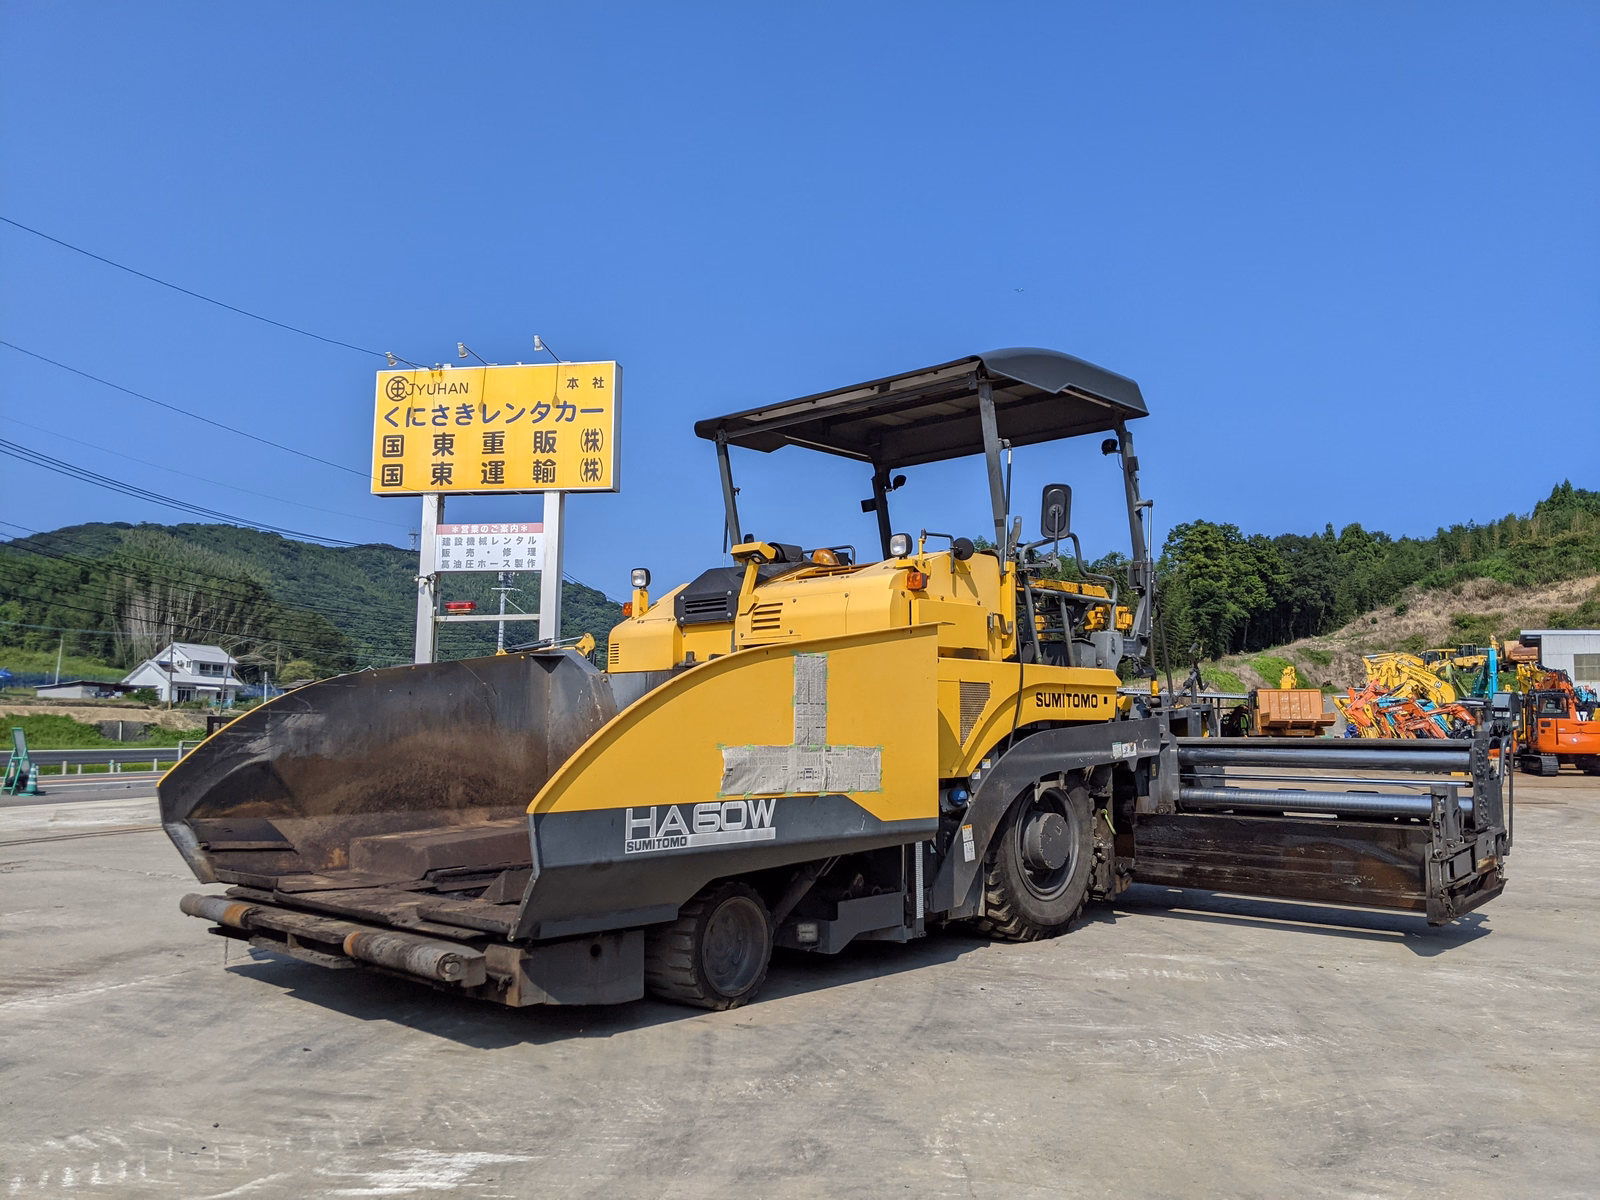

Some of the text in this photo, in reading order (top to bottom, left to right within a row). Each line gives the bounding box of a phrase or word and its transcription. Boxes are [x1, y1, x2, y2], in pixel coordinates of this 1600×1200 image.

[405, 381, 469, 396] JYUHAN
[566, 376, 605, 390] 本社
[384, 400, 604, 428] くにさきレンタカー
[441, 536, 537, 547] 建設機械レンタル
[1035, 692, 1098, 709] SUMITOMO
[625, 798, 777, 840] HA60W
[626, 836, 688, 853] SUMITOMO
